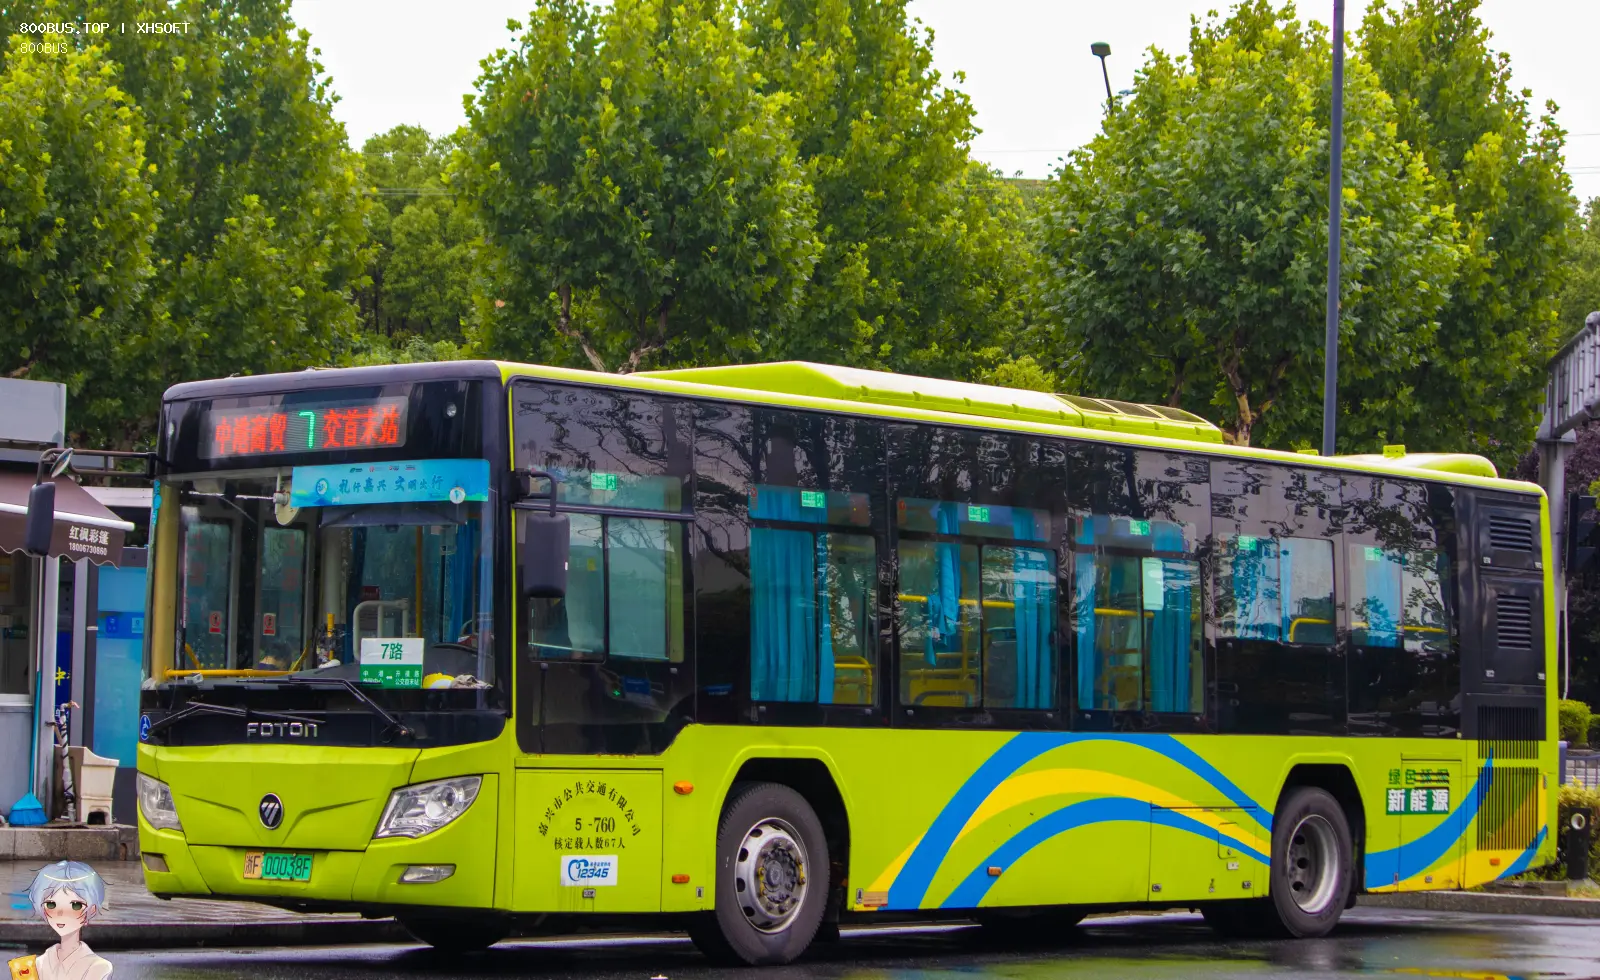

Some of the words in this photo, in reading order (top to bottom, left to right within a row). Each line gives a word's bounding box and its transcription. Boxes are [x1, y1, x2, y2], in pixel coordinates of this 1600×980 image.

[298, 410, 316, 449] 7
[381, 642, 403, 660] 7路
[247, 722, 318, 738] FOTON
[538, 780, 641, 836] 嘉兴市公共交通有限公司
[1387, 788, 1449, 812] 新能源
[554, 837, 626, 850] 核定载人数67人
[577, 868, 609, 878] 12345
